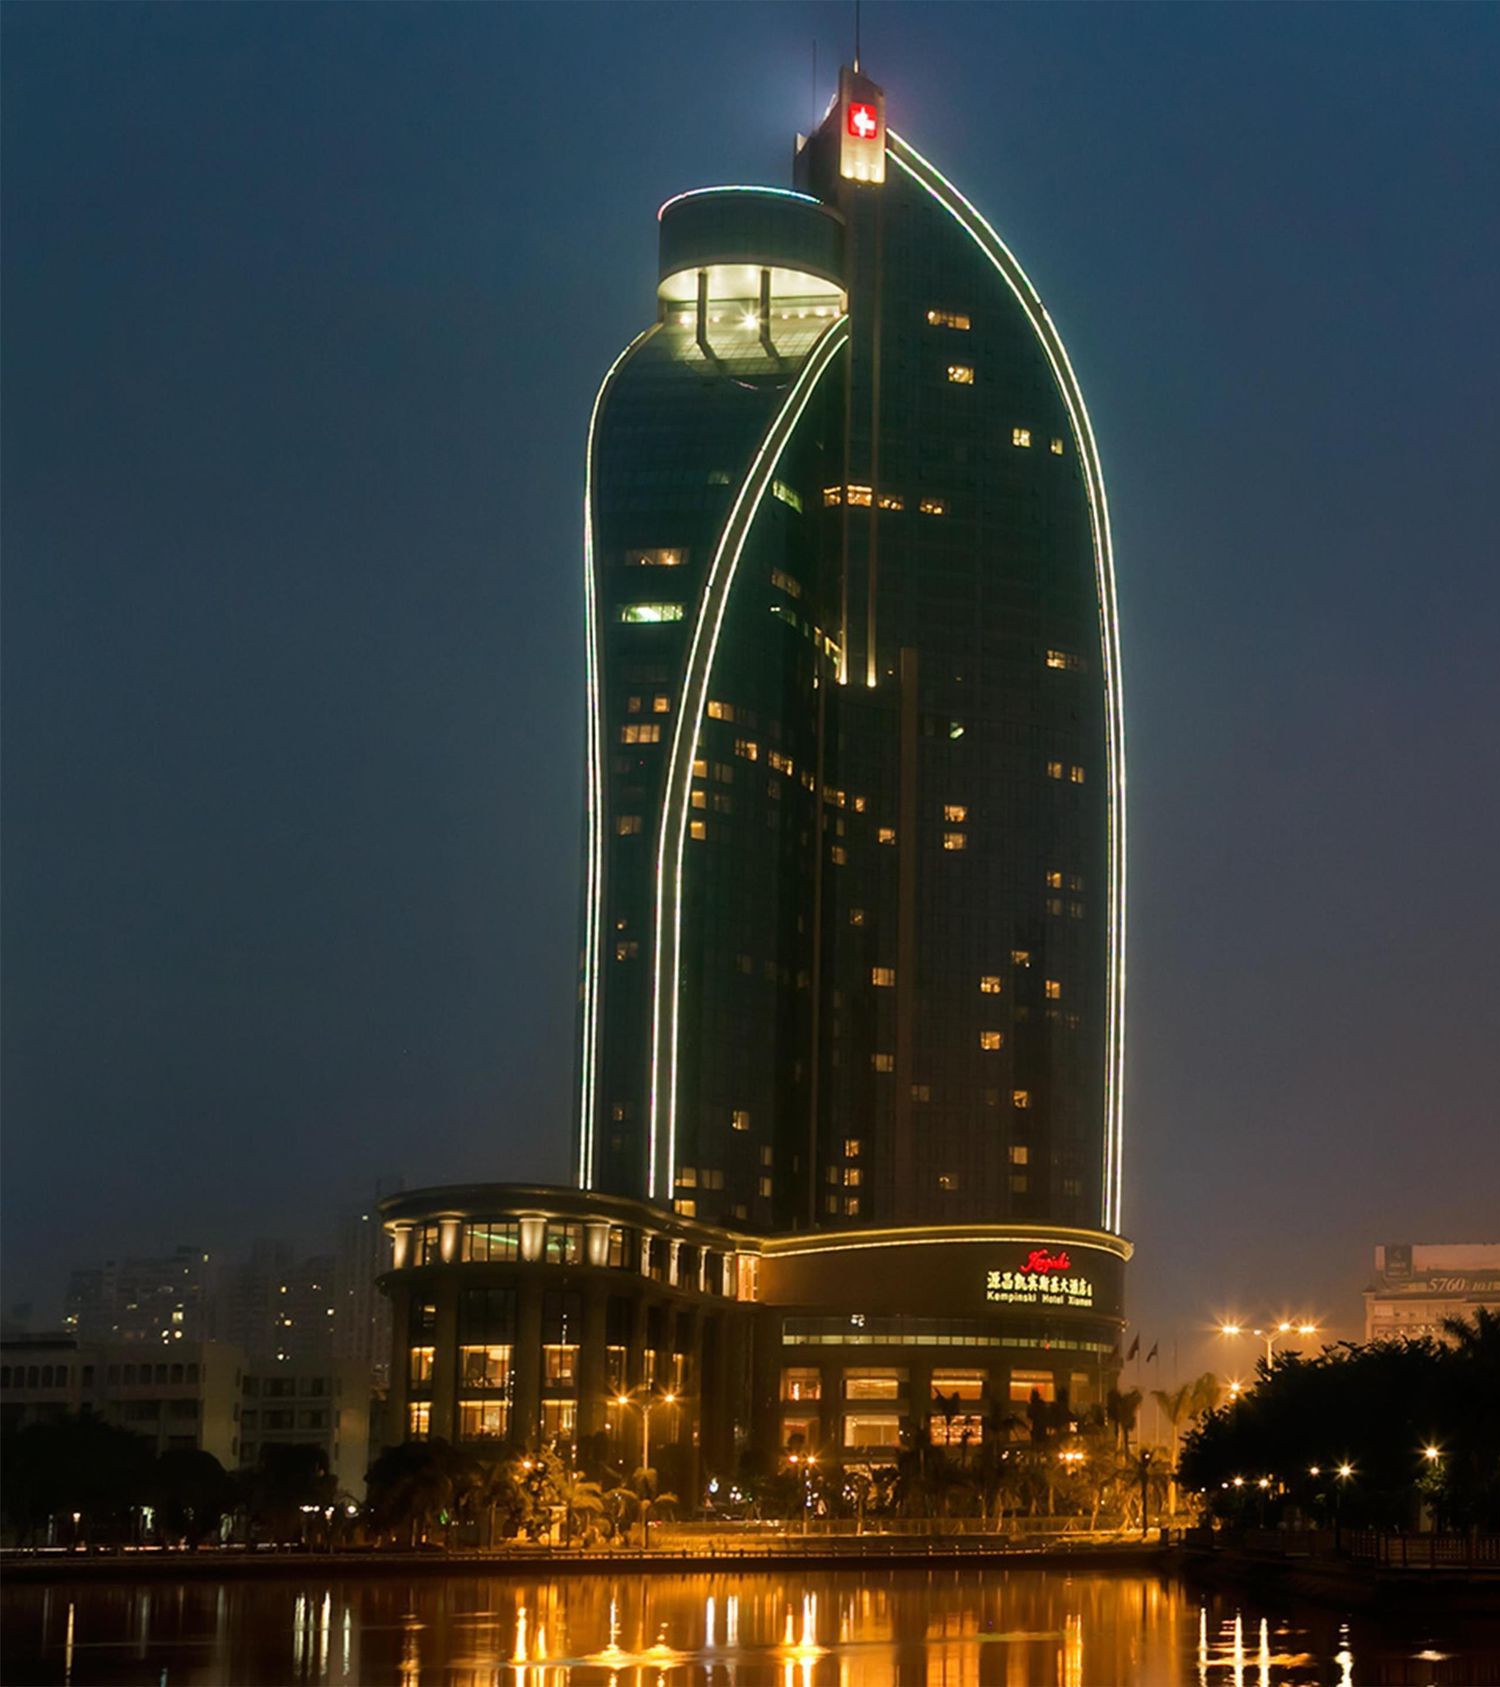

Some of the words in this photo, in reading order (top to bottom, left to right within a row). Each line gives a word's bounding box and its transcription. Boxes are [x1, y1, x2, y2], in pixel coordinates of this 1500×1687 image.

[1428, 1278, 1465, 1292] 5760
[987, 1291, 1036, 1303] Kempinski
[1042, 1294, 1064, 1304] Hotel
